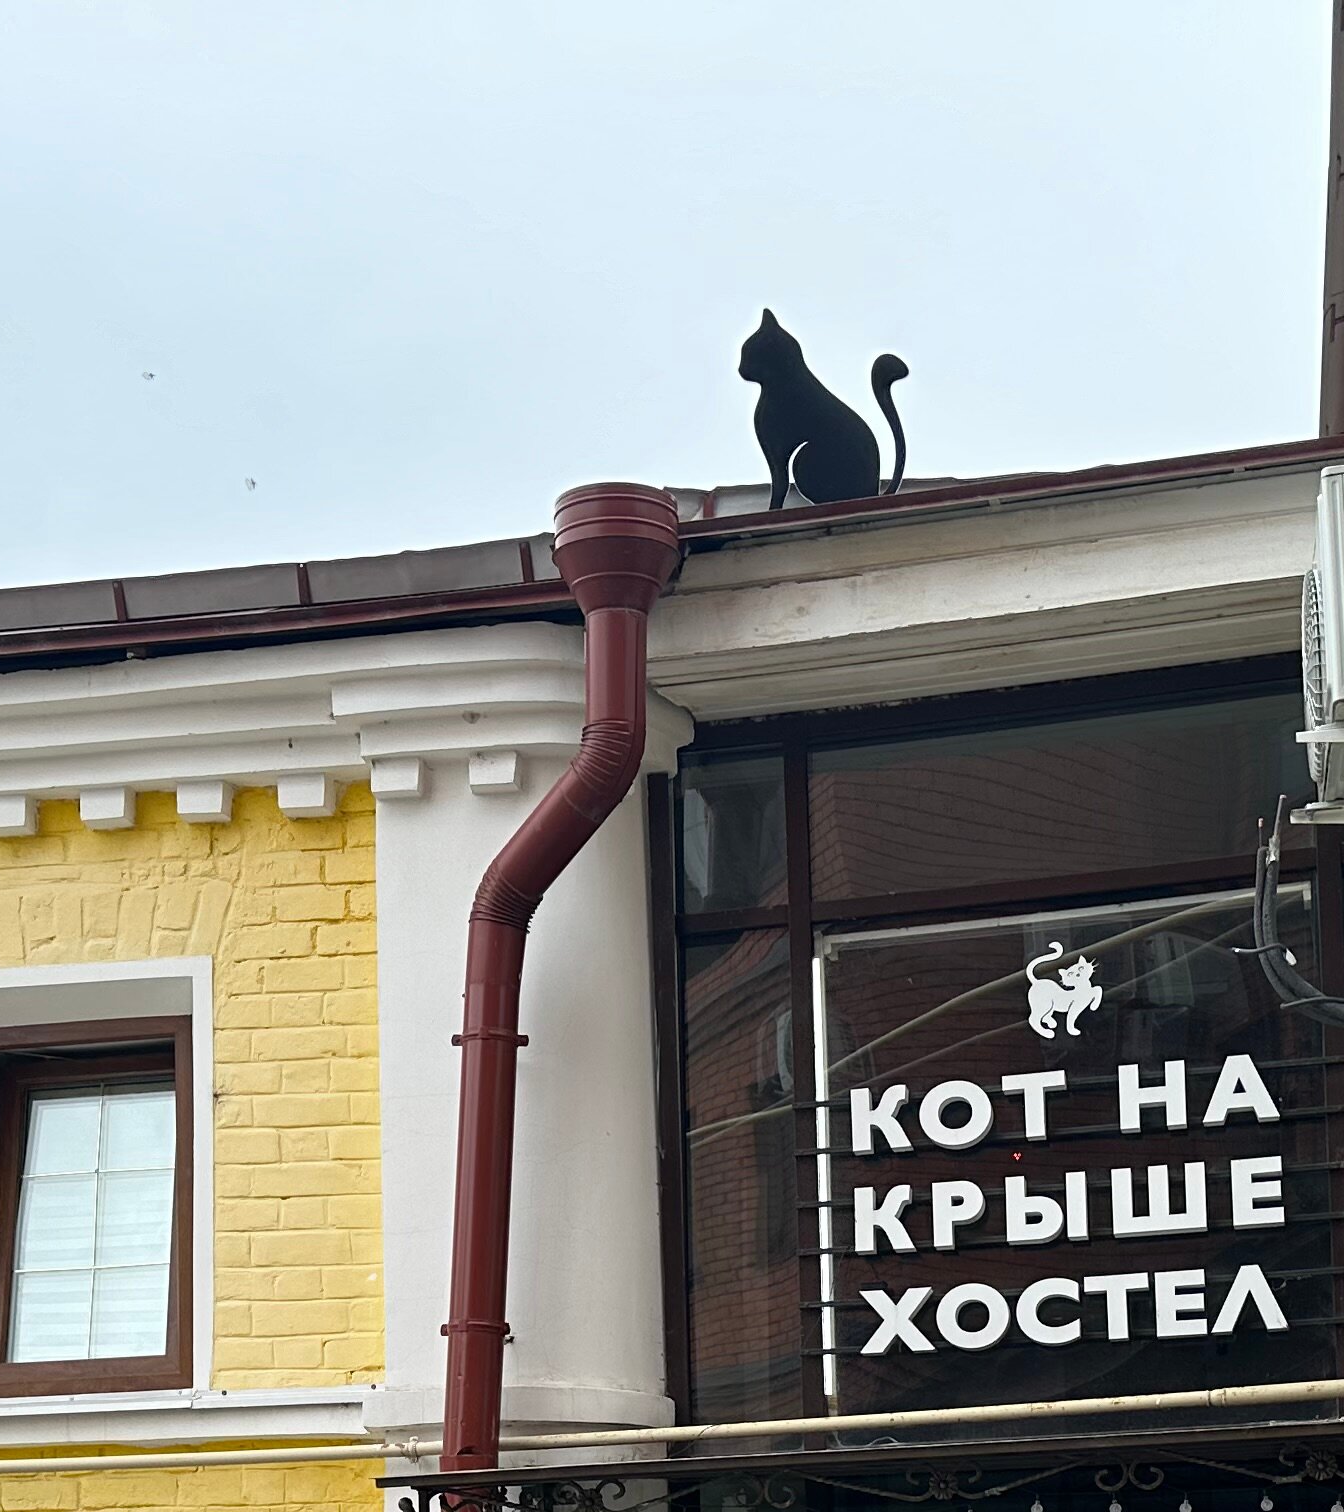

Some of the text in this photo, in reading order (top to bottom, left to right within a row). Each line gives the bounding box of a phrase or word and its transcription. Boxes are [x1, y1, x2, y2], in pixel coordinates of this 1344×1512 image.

[849, 1054, 1281, 1156] КОТ НА
[854, 1155, 1286, 1255] КРЫШЕ
[859, 1262, 1290, 1357] ХОСТЕЛ
